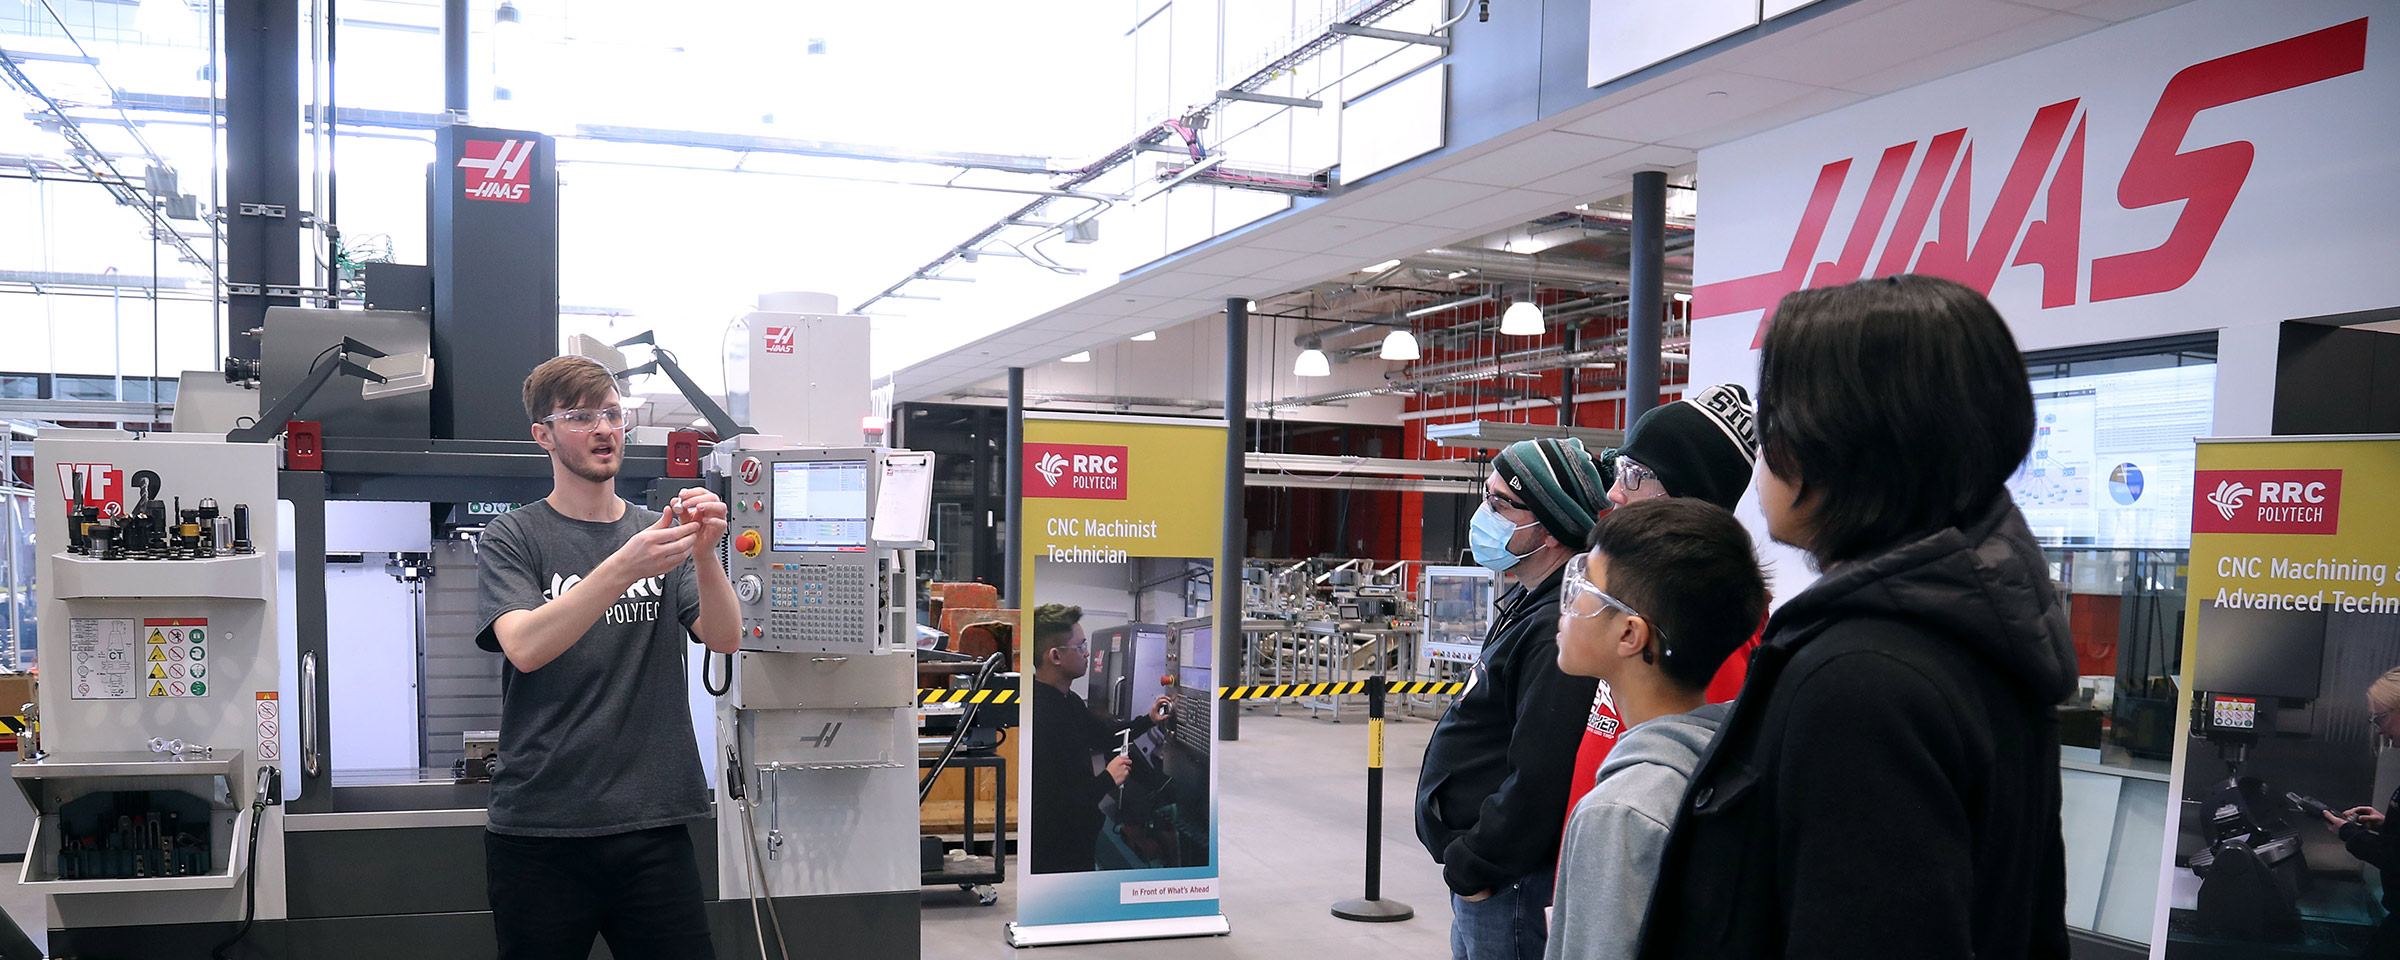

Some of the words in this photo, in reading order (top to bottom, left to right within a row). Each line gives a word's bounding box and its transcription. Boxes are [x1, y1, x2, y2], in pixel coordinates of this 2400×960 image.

[465, 181, 530, 199] HAAS
[1691, 17, 2369, 349] HAAS
[766, 344, 794, 353] HAAS
[1707, 391, 1757, 450] STO
[1073, 454, 1118, 474] RRC
[1073, 475, 1118, 490] POLYTECH
[2259, 481, 2327, 504] RRC
[2257, 506, 2323, 522] POLYTECH
[1047, 517, 1079, 536] CNC
[1084, 518, 1157, 538] Machinist
[1046, 544, 1128, 564] Technician
[2217, 556, 2263, 579] CNC
[2270, 557, 2387, 587] Machining
[619, 573, 665, 599] RC
[2213, 586, 2324, 612] Advanced
[2332, 590, 2400, 615] Techn
[108, 651, 124, 660] CT
[1132, 888, 1139, 897] In
[1140, 887, 1158, 896] Front
[1159, 887, 1166, 895] of
[1167, 886, 1189, 895] What's
[1190, 885, 1210, 894] Ahead
